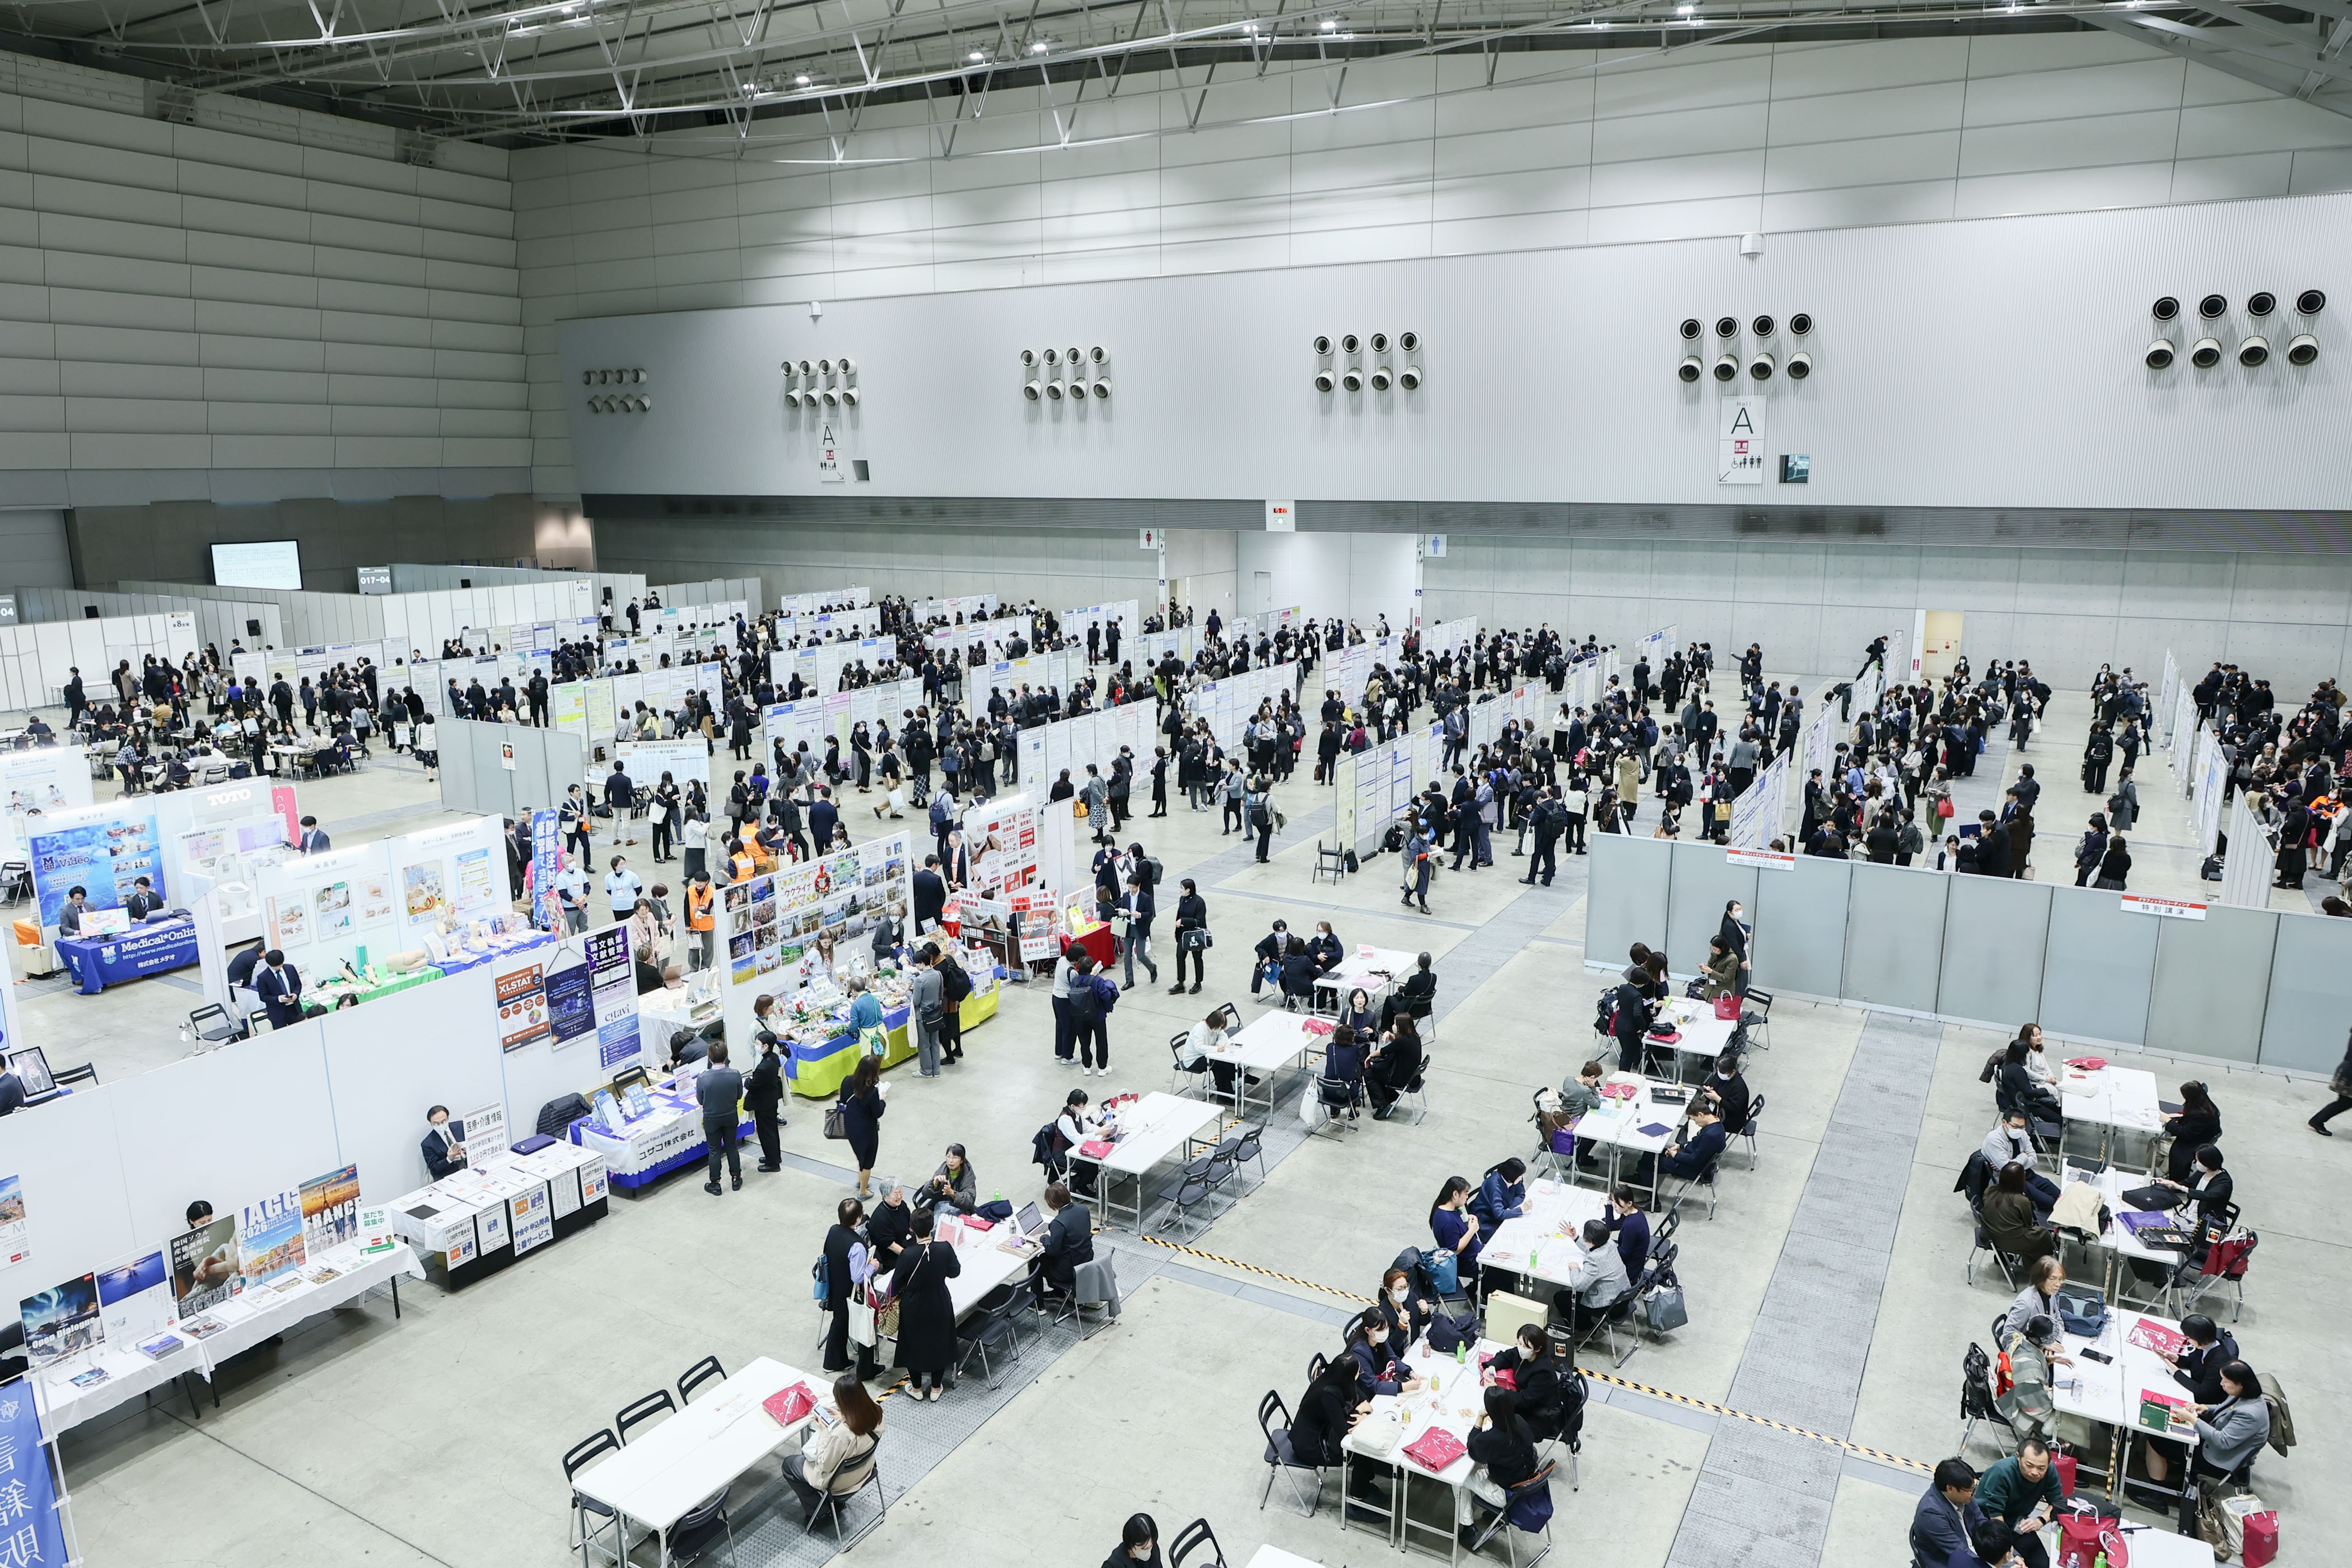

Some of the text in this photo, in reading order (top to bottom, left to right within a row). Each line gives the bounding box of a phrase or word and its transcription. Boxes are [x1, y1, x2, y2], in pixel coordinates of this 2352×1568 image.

[1731, 408, 1753, 434] A
[823, 426, 835, 445] A
[360, 576, 390, 585] 017-04
[207, 788, 251, 806] TOTO
[59, 857, 90, 867] Video
[785, 884, 811, 897] ウクライナ
[2138, 897, 2190, 907] グラフィックレコーディング
[2142, 904, 2185, 915] 特別講演
[590, 934, 623, 952] 論文執筆
[137, 954, 175, 969] 株式会社メテオ
[591, 944, 623, 962] 文献管理
[596, 957, 612, 967] EndNote
[498, 976, 531, 995] XLSTAT
[466, 1110, 502, 1133] 医療・介護 情報
[638, 1140, 649, 1148] Drive
[660, 1126, 679, 1138] Research
[639, 1130, 695, 1160] ユサコ株式会社
[237, 1188, 300, 1230] IAGG
[363, 1210, 384, 1219] 友だち
[364, 1217, 385, 1227] 募集中
[173, 1230, 209, 1248] 韓国ソウル
[241, 1221, 268, 1242] 2026
[515, 1226, 529, 1238] 学会中
[174, 1236, 211, 1256] 産後調理院
[175, 1246, 204, 1264] 医療視察
[31, 1316, 96, 1350] Open Dialogue
